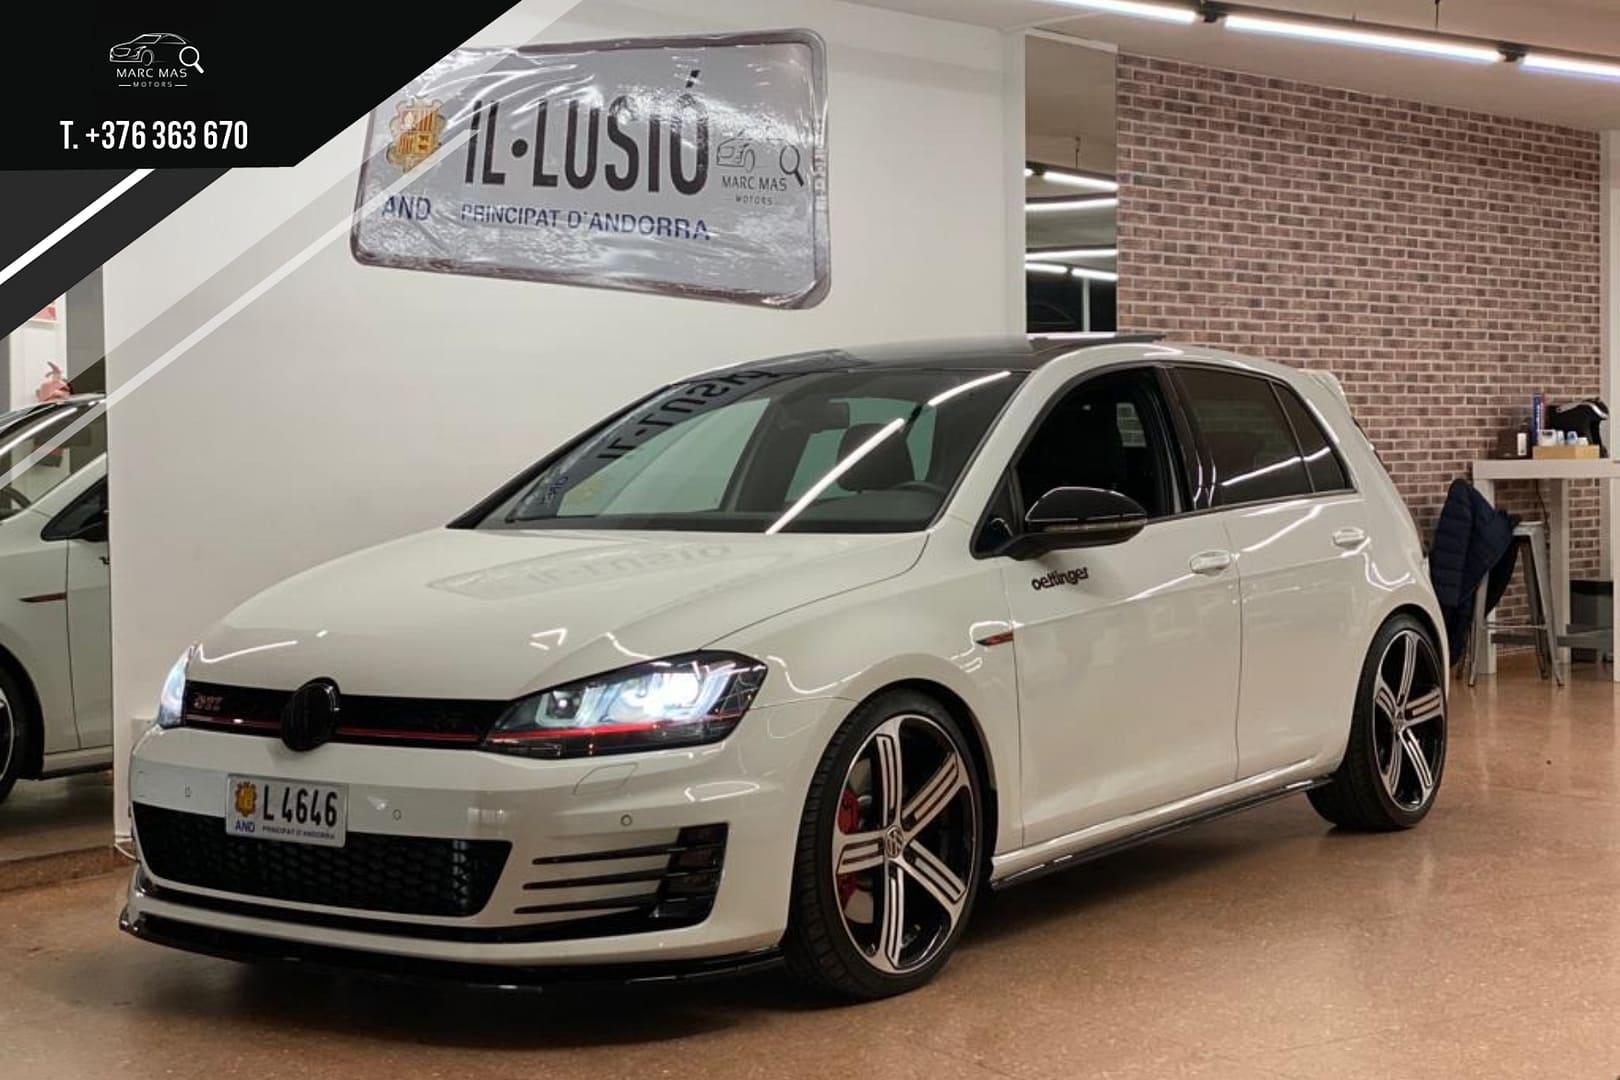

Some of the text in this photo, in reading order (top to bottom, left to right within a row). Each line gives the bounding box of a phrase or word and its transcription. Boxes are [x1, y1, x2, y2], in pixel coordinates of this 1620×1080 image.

[722, 175, 787, 192] MARC MAS
[382, 195, 431, 221] AND
[461, 204, 711, 241] PRINCIPAT D'ANDORRA
[263, 784, 338, 827] L 4646
[235, 820, 255, 832] AND
